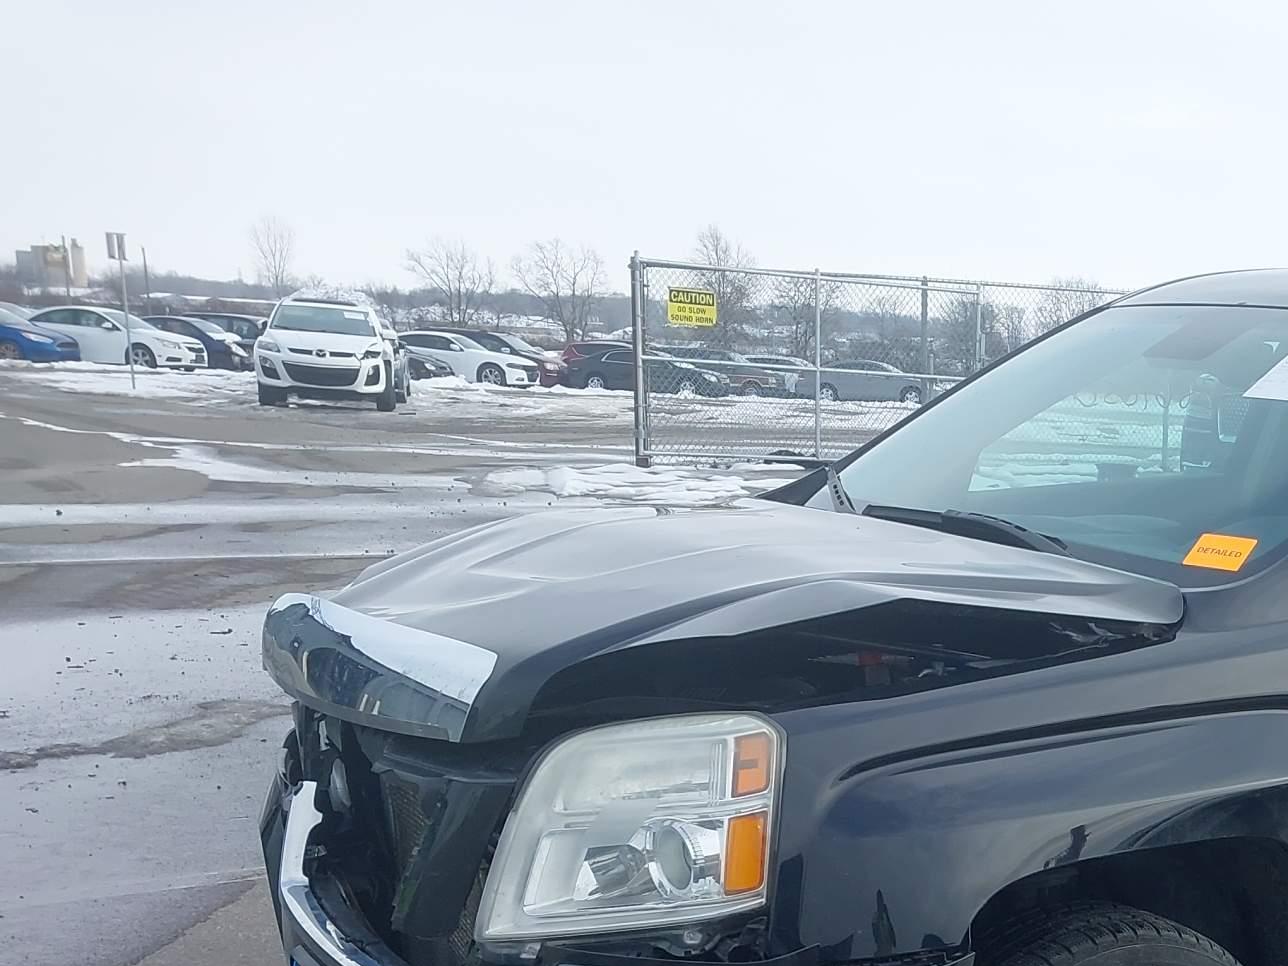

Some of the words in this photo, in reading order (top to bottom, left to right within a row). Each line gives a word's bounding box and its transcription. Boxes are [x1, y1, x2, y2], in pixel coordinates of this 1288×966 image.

[671, 291, 713, 305] CAUTION
[677, 305, 687, 313] GO
[688, 306, 707, 316] SLOW
[670, 314, 693, 323] SOUND
[695, 316, 714, 325] HORN
[1197, 546, 1242, 558] DETAILED
